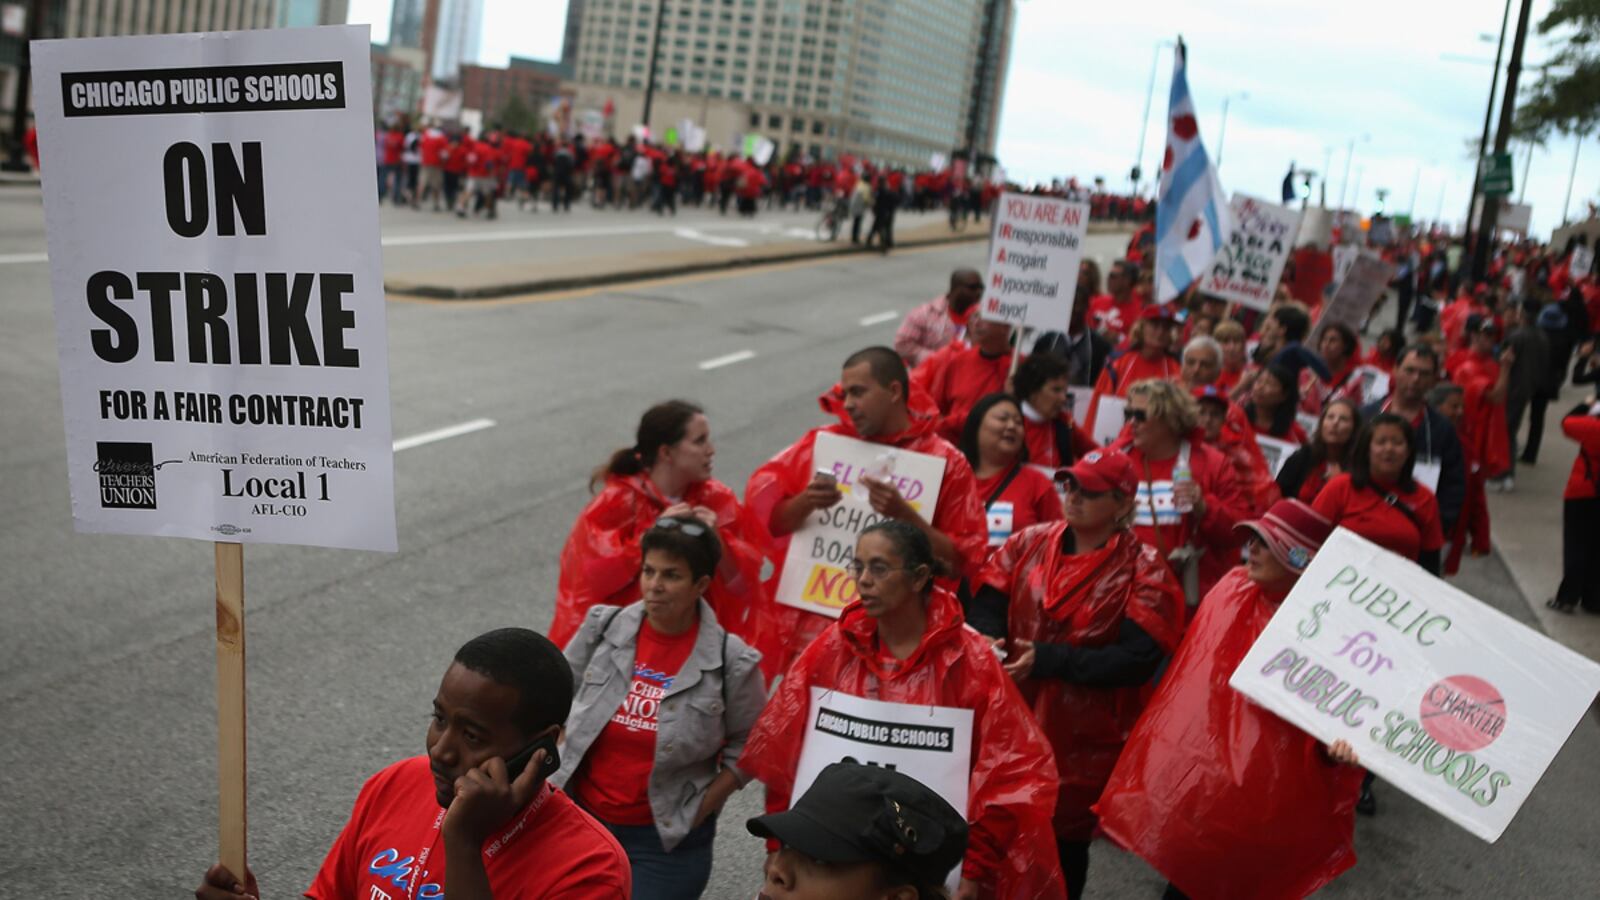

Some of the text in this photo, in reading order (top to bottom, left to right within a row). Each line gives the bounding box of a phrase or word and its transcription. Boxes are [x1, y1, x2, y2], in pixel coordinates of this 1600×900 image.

[70, 73, 338, 109] CHICAGO PUBLIC SCHOOLS
[163, 140, 267, 238] ON
[1007, 199, 1081, 225] YOU ARE AN
[86, 270, 360, 368] STRIKE
[99, 390, 364, 429] FOR A FAIR CONTRACT
[188, 450, 367, 471] American Federation of Teachers
[100, 474, 154, 488] TEACHERS
[102, 487, 155, 505] UNION
[221, 469, 331, 501] Local 1
[251, 503, 307, 517] AFL-CIO
[811, 536, 856, 570] BOA
[1325, 564, 1451, 646] PUBLIC
[1296, 598, 1394, 677] $ for
[1260, 647, 1511, 809] PUBLIC SCHOOLS
[1429, 684, 1506, 737] CHARTER
[818, 712, 949, 748] CHICAGO PUBLIC SCHOOLS
